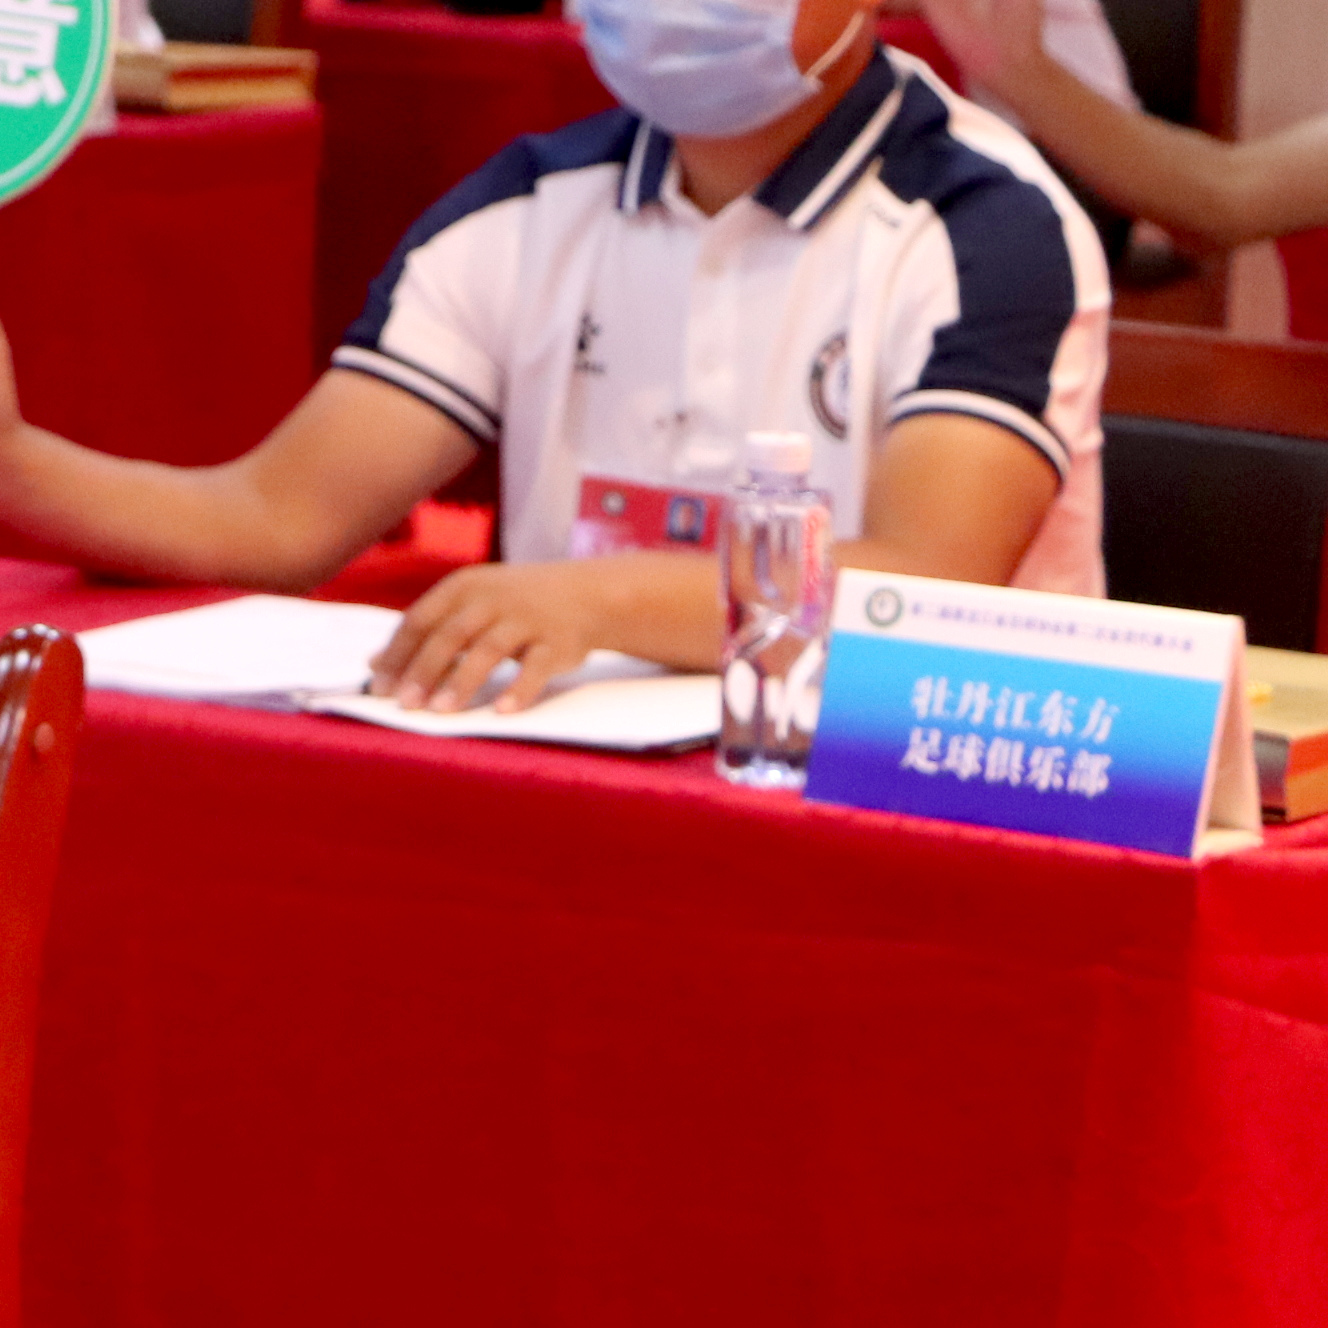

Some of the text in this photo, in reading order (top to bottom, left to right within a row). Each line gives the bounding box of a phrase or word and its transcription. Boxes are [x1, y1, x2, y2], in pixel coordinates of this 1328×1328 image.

[911, 676, 1120, 744] 牡丹江东方
[900, 727, 1113, 799] 足球俱乐部
